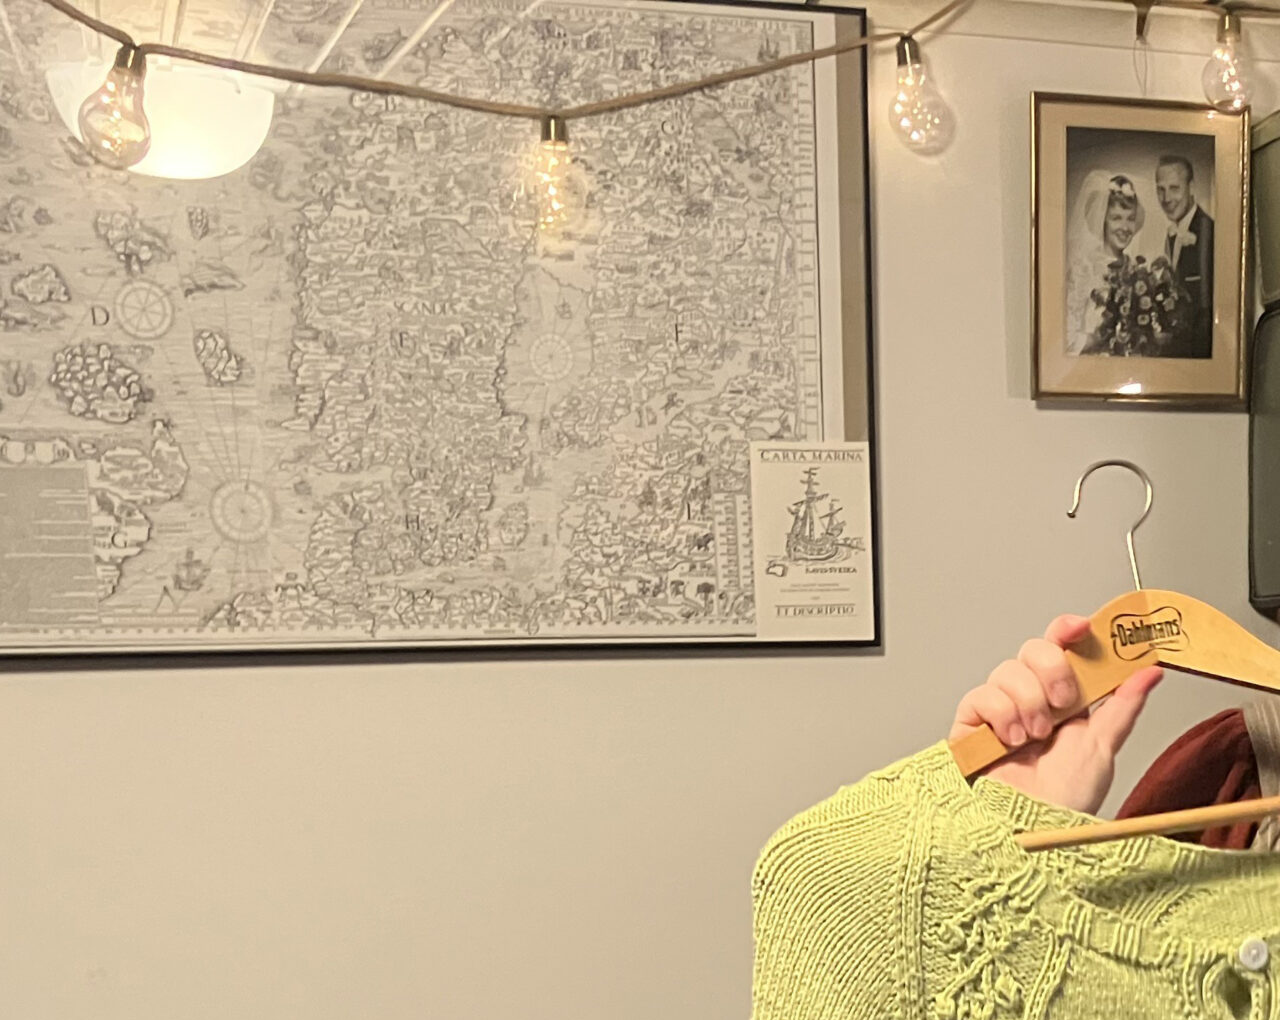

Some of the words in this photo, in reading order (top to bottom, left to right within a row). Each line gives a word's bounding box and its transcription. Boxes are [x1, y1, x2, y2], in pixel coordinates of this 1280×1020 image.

[91, 305, 110, 326] D
[760, 450, 806, 462] CARTA
[812, 450, 863, 462] MARINA
